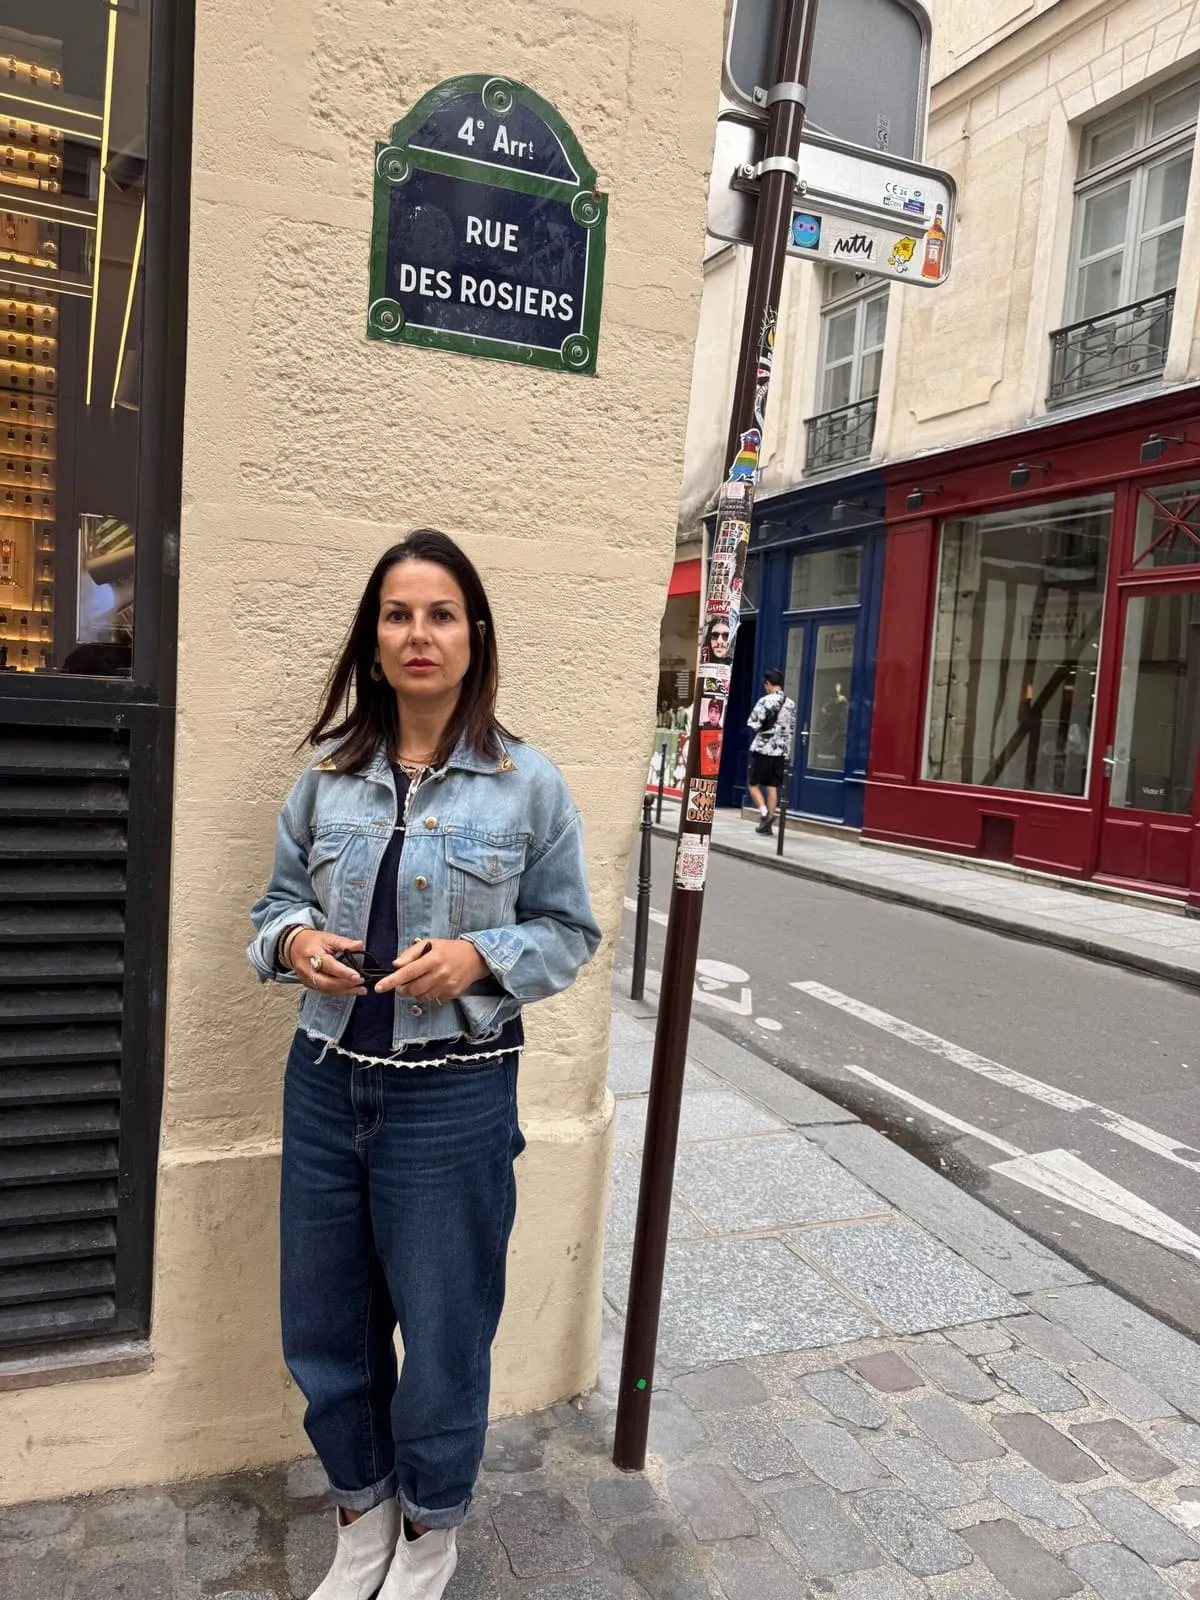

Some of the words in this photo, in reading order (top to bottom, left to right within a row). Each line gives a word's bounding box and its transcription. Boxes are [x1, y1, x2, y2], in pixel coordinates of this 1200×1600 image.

[465, 215, 519, 252] RUE
[399, 262, 452, 299] DES
[459, 274, 574, 321] ROSIERS
